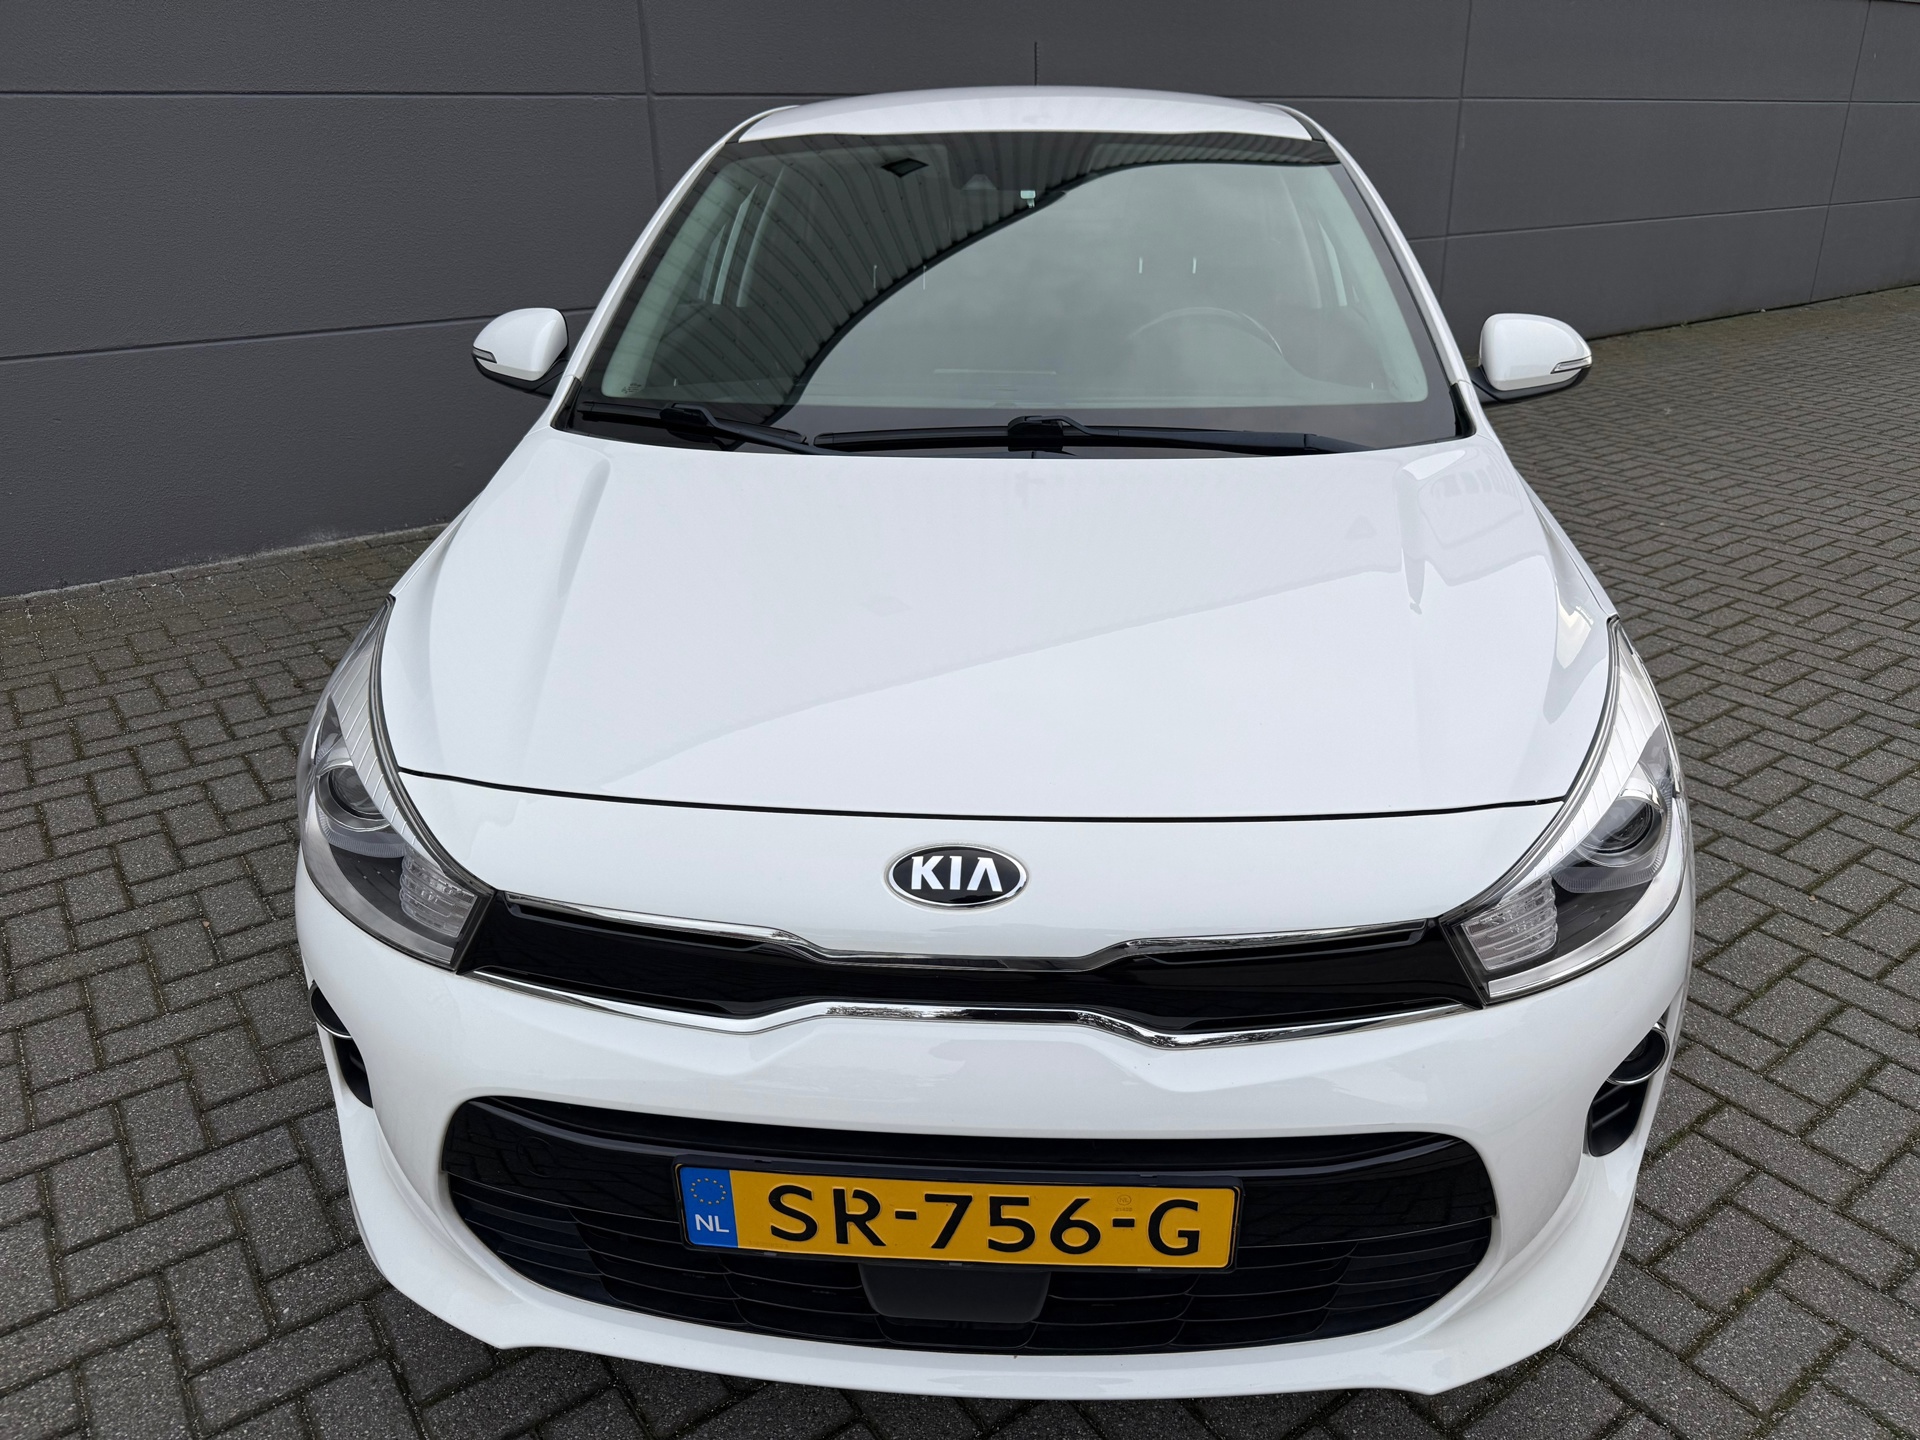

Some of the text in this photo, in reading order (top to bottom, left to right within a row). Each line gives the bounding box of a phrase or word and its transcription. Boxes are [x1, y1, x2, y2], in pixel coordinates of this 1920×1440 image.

[911, 855, 1003, 892] KIA
[694, 1213, 730, 1233] NL
[768, 1184, 1200, 1257] SR-756-G
